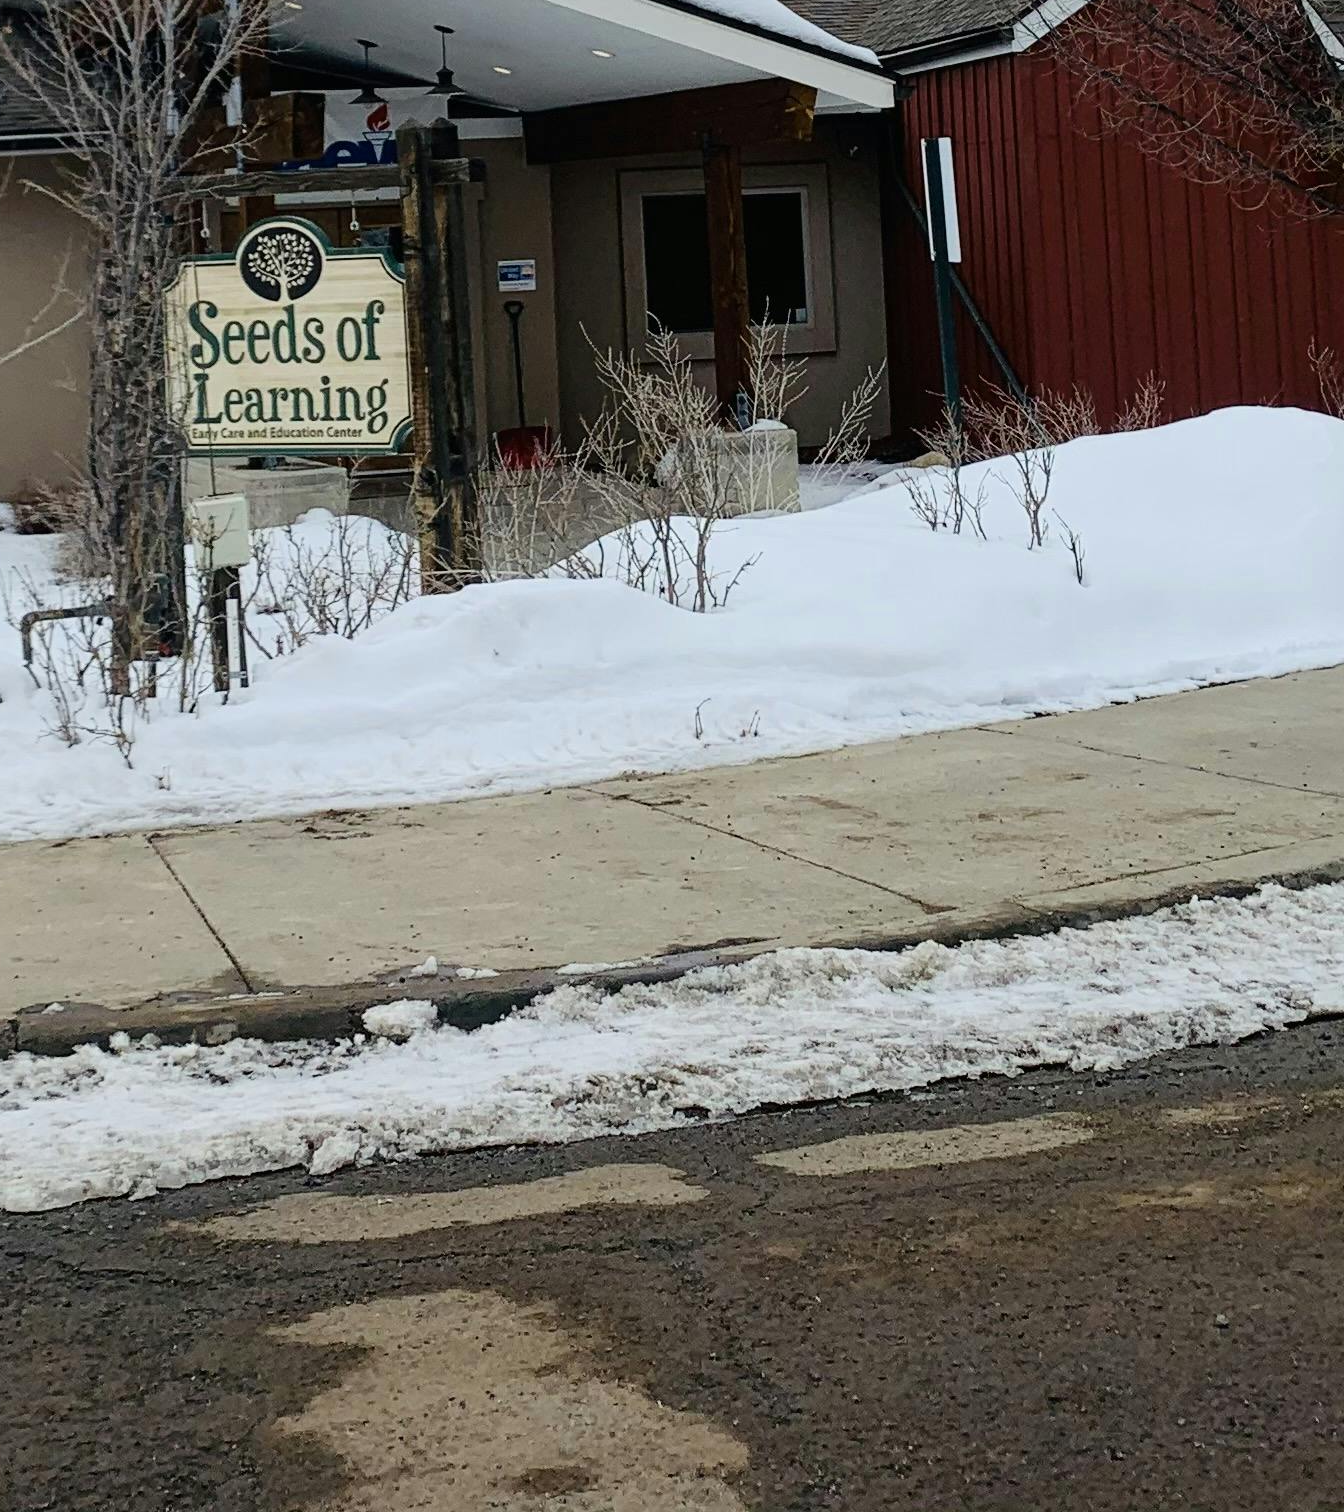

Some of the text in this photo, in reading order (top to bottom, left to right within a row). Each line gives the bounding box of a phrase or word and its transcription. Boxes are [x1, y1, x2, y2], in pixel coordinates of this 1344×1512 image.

[188, 299, 385, 369] Seeds of
[192, 373, 389, 434] Learning
[192, 426, 363, 441] Eary Care and Education Center
